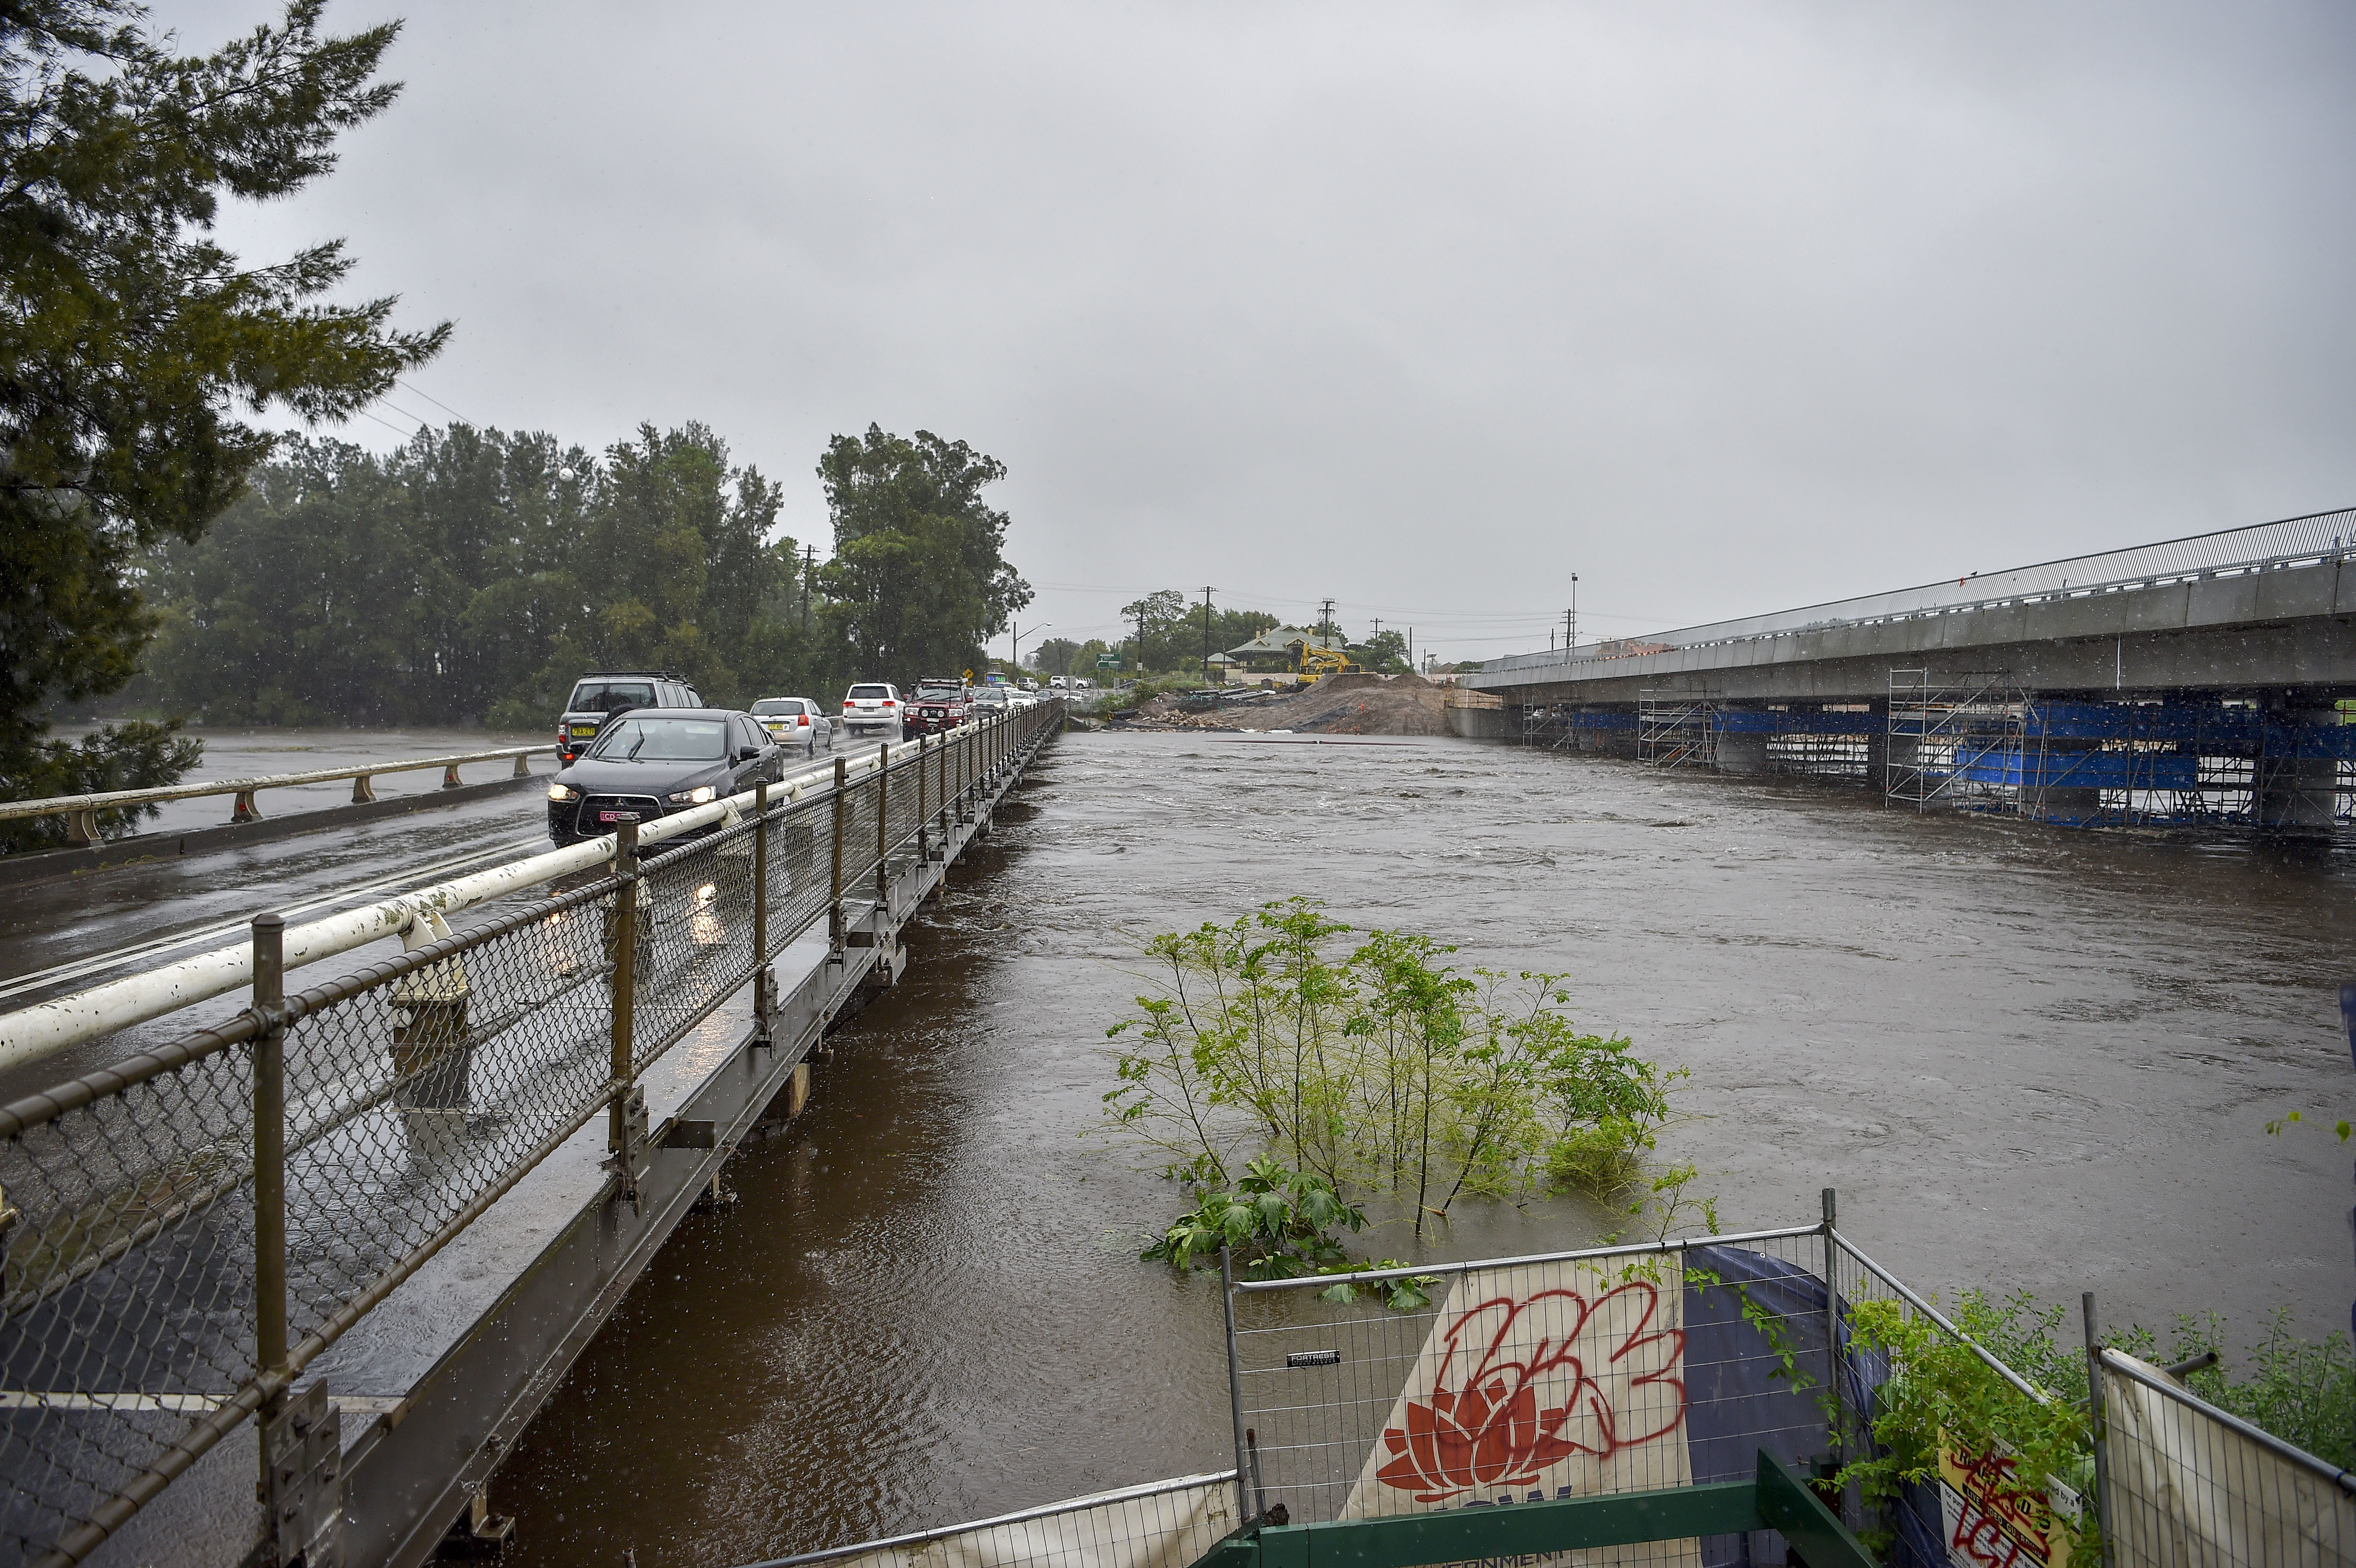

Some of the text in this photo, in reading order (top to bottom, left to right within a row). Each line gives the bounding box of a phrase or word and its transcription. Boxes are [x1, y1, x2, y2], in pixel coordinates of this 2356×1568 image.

[1291, 1352, 1335, 1361] FORTRESS
[2061, 1490, 2069, 1503] by
[1952, 1497, 1974, 1521] purpses
[1966, 1488, 2043, 1560] LIVE IDEO GURDING
